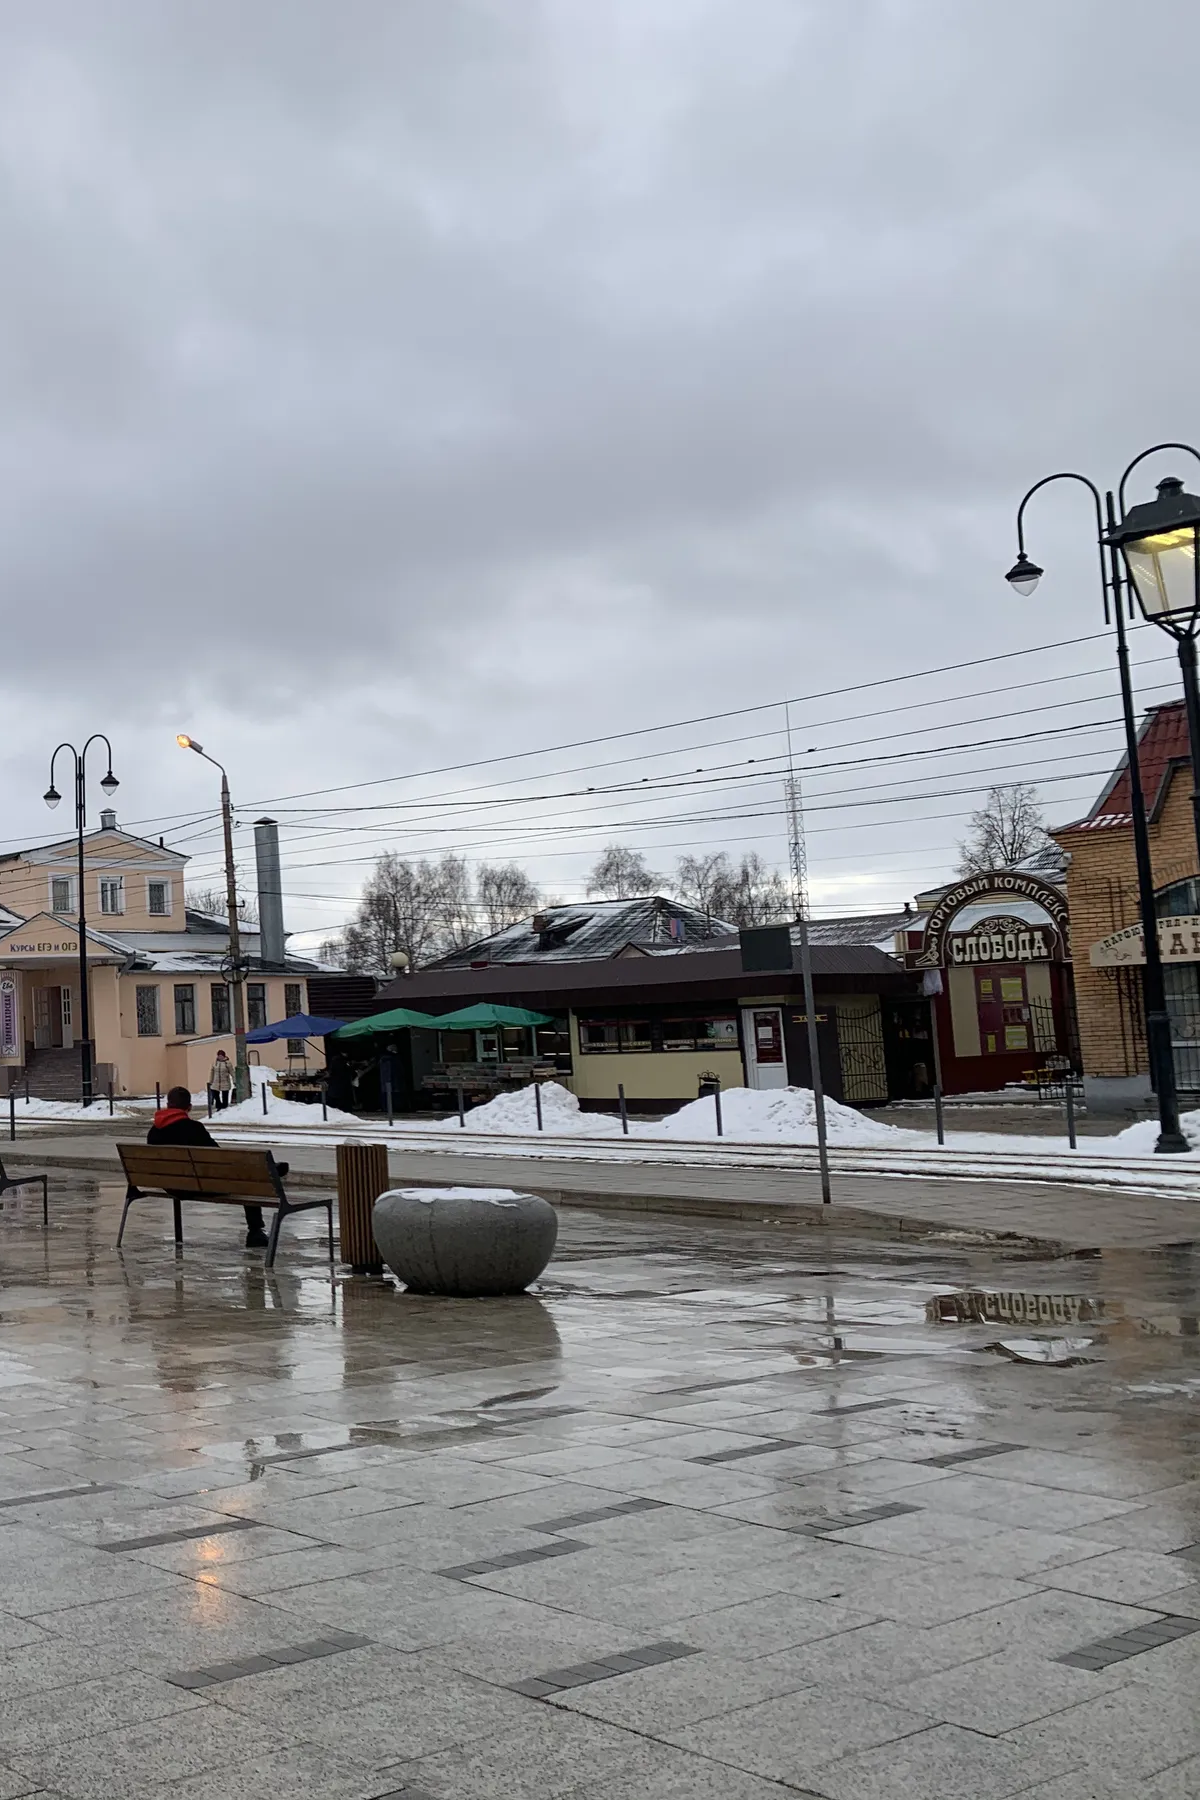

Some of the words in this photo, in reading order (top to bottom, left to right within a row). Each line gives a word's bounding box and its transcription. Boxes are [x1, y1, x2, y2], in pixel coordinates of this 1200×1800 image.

[928, 876, 990, 936] ТОРГОВЫЙ
[995, 877, 1068, 922] КОМПЛЕКС
[37, 942, 52, 952] ЕГЭ
[61, 942, 78, 952] ОГЭ
[952, 931, 1048, 962] СЛОБОДА
[4, 994, 12, 1045] ПАРИКМАХЕРСКАЯ
